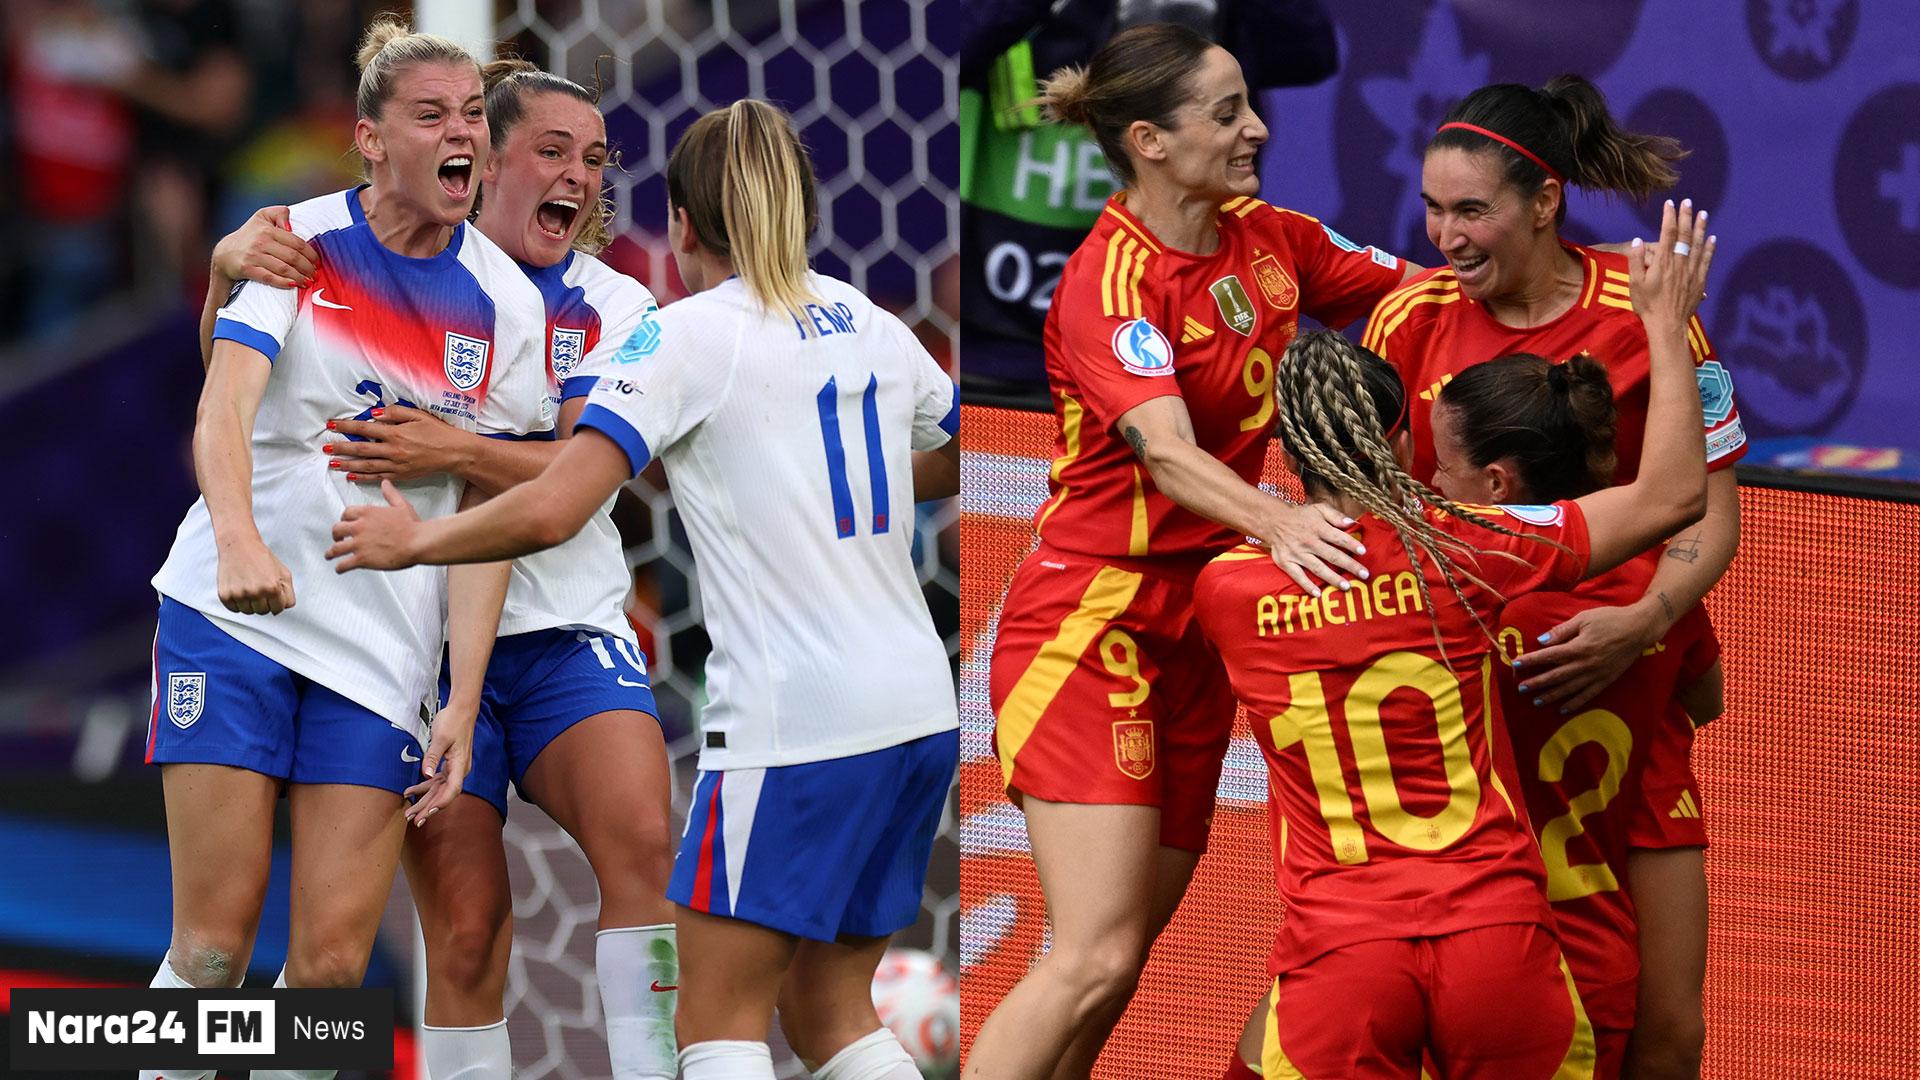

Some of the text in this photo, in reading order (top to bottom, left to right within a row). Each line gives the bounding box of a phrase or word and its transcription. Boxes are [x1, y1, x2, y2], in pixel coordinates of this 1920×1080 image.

[791, 302, 857, 340] HEMP
[1234, 311, 1249, 323] FIFA
[1240, 347, 1274, 432] 9
[817, 371, 889, 539] 11
[1257, 571, 1424, 637] ATHENEA
[577, 631, 647, 676] 10
[1099, 629, 1150, 708] 9
[1269, 651, 1481, 865] 10
[1538, 708, 1634, 902] 2
